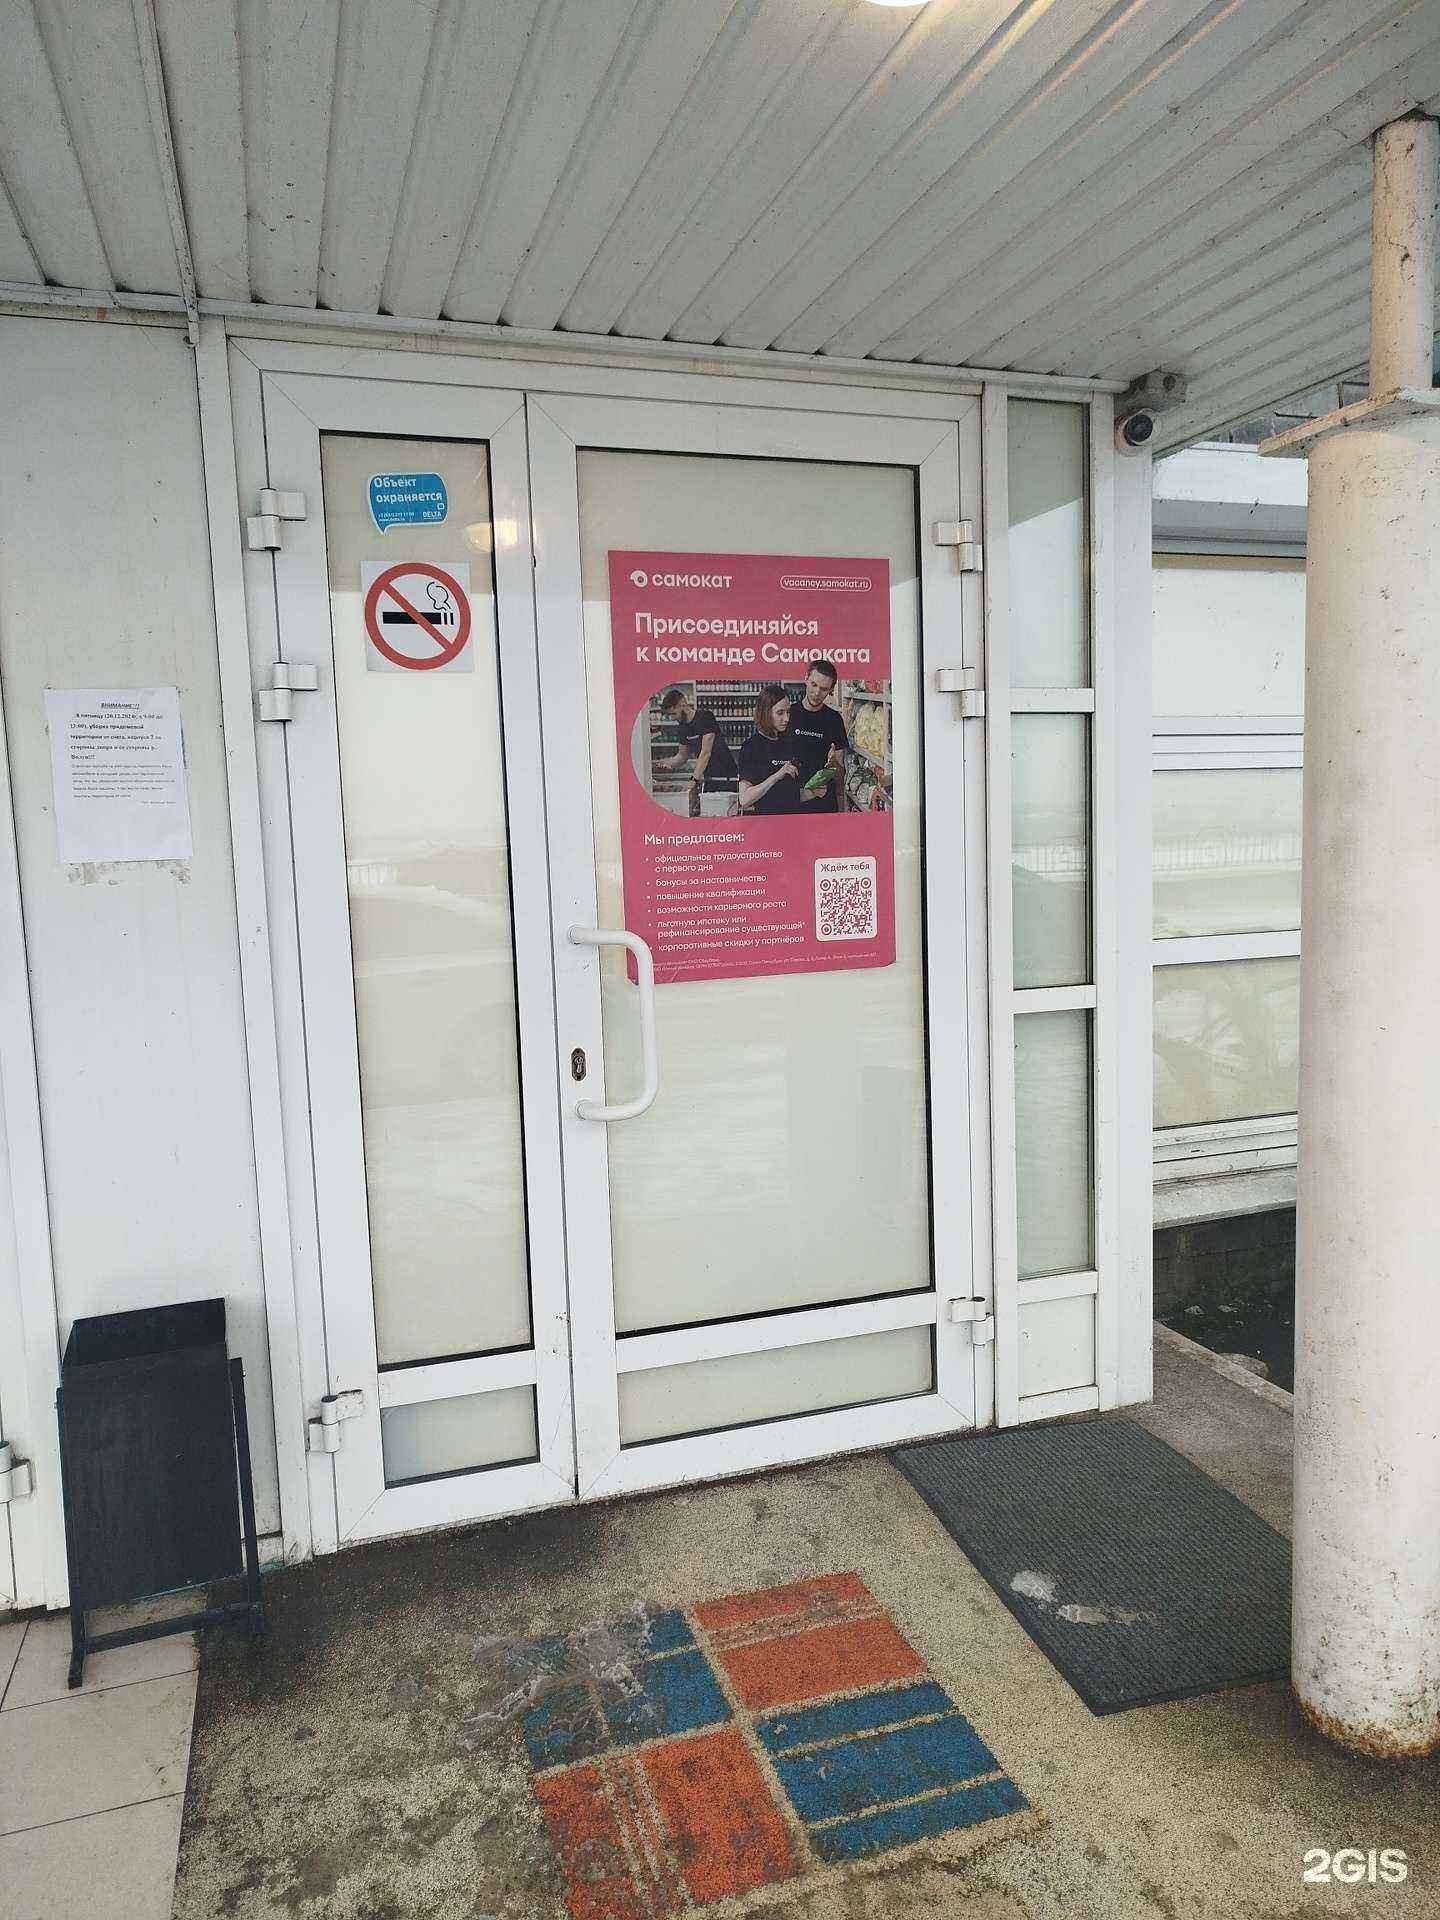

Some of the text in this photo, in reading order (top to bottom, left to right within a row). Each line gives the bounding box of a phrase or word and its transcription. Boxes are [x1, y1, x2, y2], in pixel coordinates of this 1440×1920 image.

[374, 477, 417, 488] Объект
[376, 492, 443, 504] охраняется
[652, 573, 733, 588] самокат
[783, 578, 869, 589] vacancy.samokat.ru
[635, 612, 819, 639] Присоединяйся
[635, 642, 870, 665] к команде Самоката
[644, 832, 745, 846] Мы предлагаем:
[655, 850, 783, 864] официальное трудоустройство
[662, 864, 697, 874] первого
[698, 864, 713, 872] дня
[850, 861, 870, 871] тебя
[656, 878, 688, 888] бонусы
[700, 875, 767, 885] наставничество
[656, 887, 766, 901] повышение квалификации
[656, 900, 787, 914] возможности карьерного роста
[657, 915, 747, 928] льготную ипотеку или
[657, 925, 740, 939] рефинансирование
[658, 940, 723, 952] корпоративные
[724, 937, 754, 946] скидки
